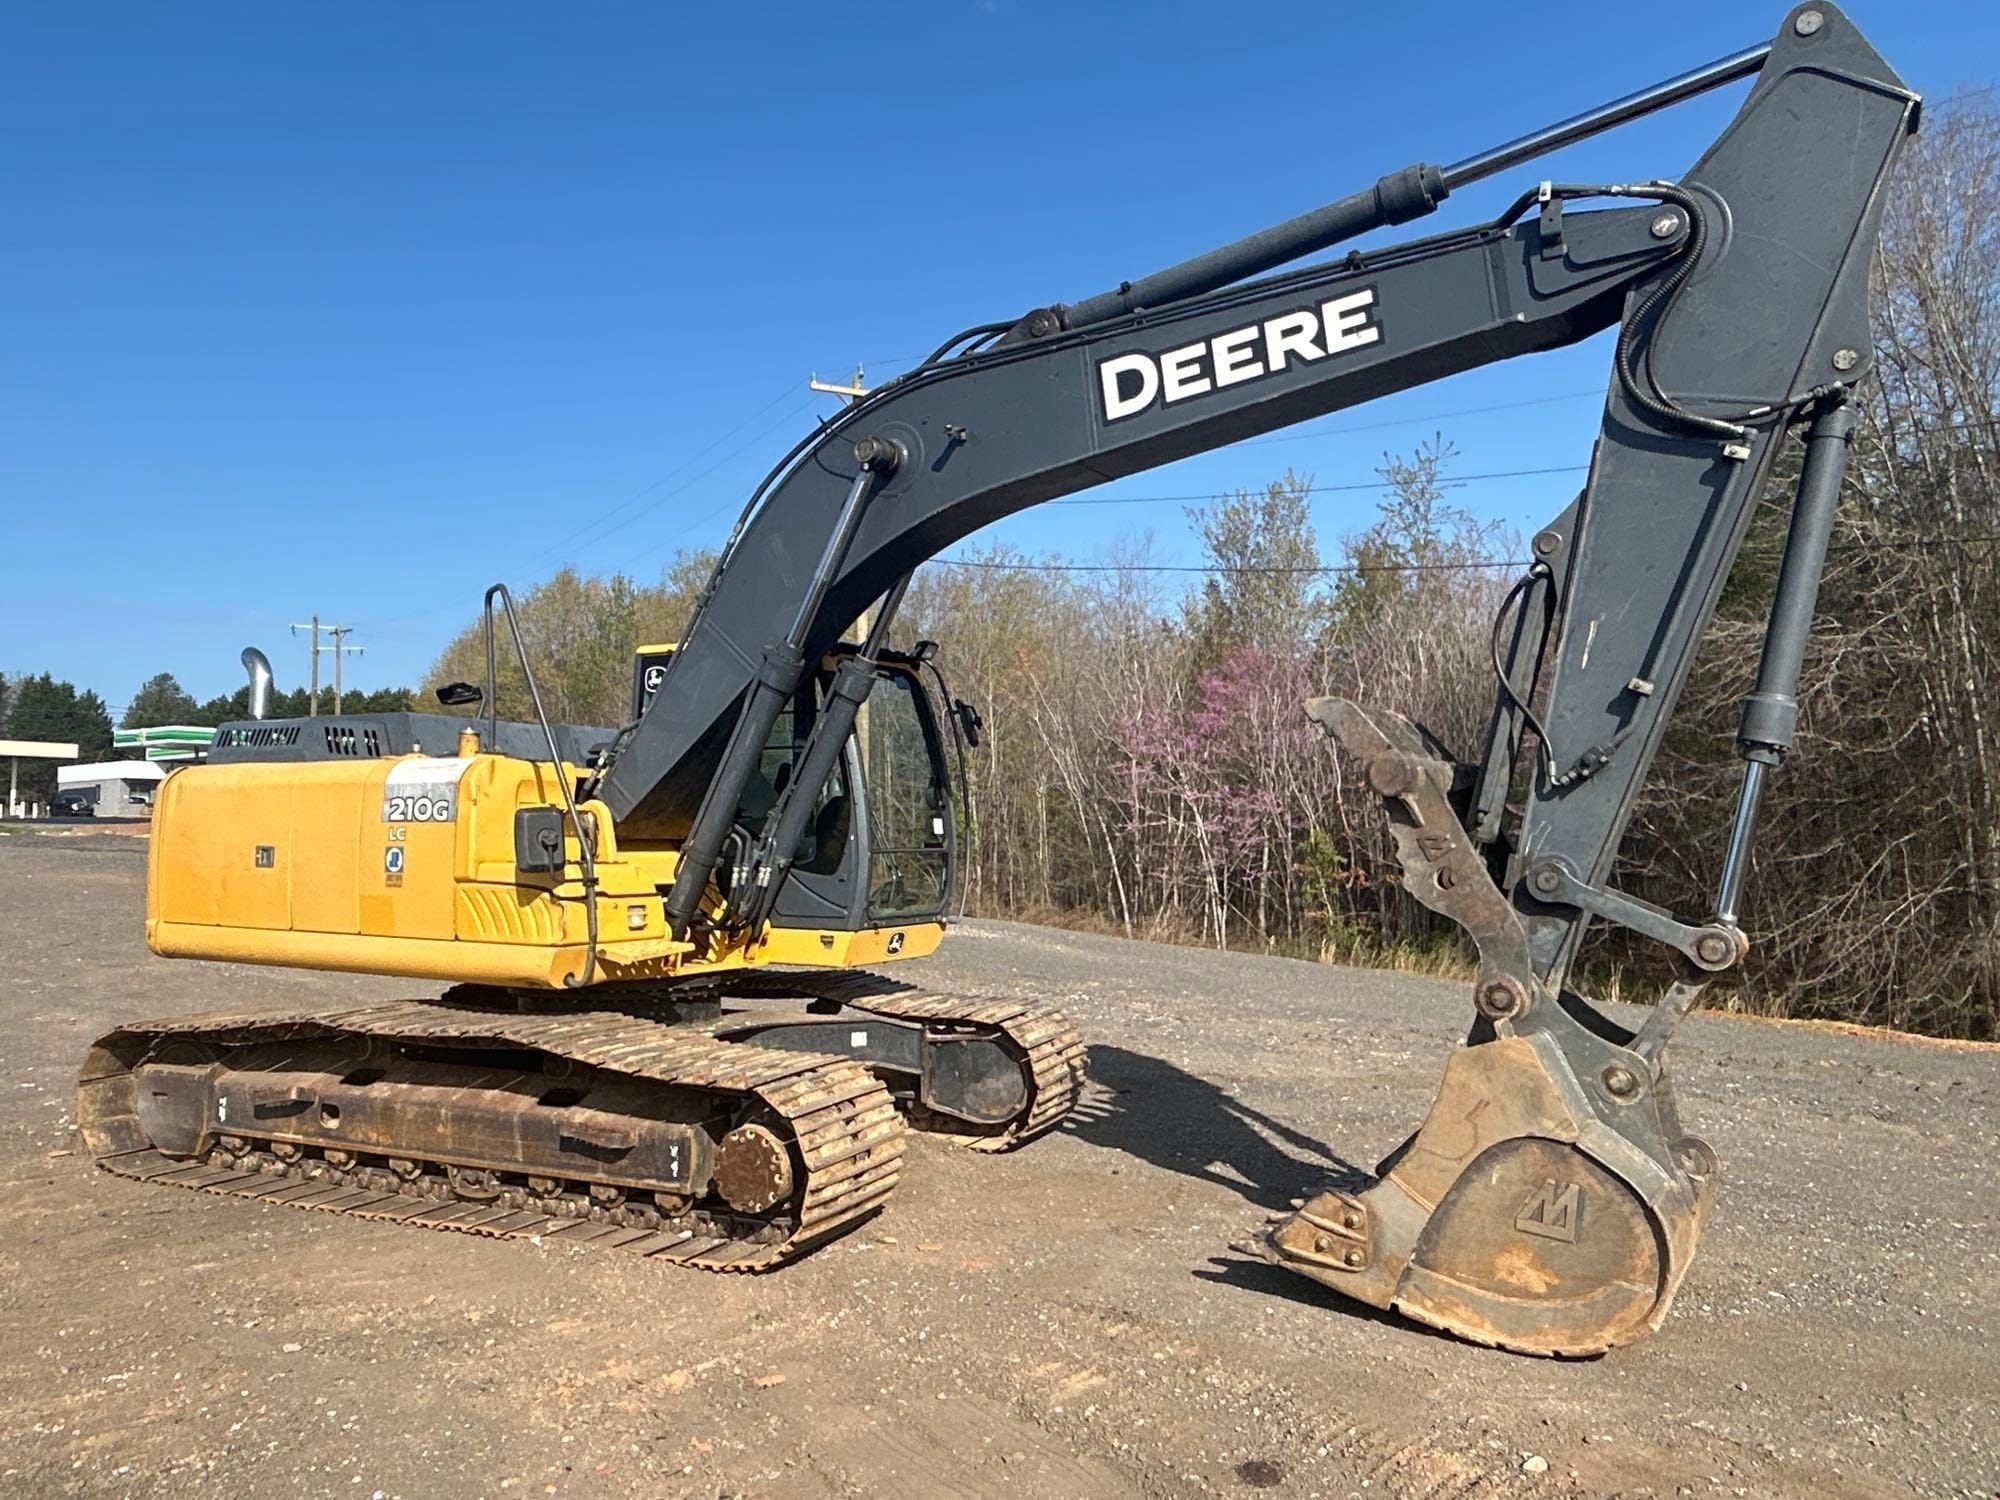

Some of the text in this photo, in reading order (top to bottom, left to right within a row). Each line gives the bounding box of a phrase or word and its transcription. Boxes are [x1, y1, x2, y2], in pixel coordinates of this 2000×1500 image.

[1100, 288, 1380, 421] DEERE
[388, 796, 449, 822] 210G
[388, 826, 406, 841] LC
